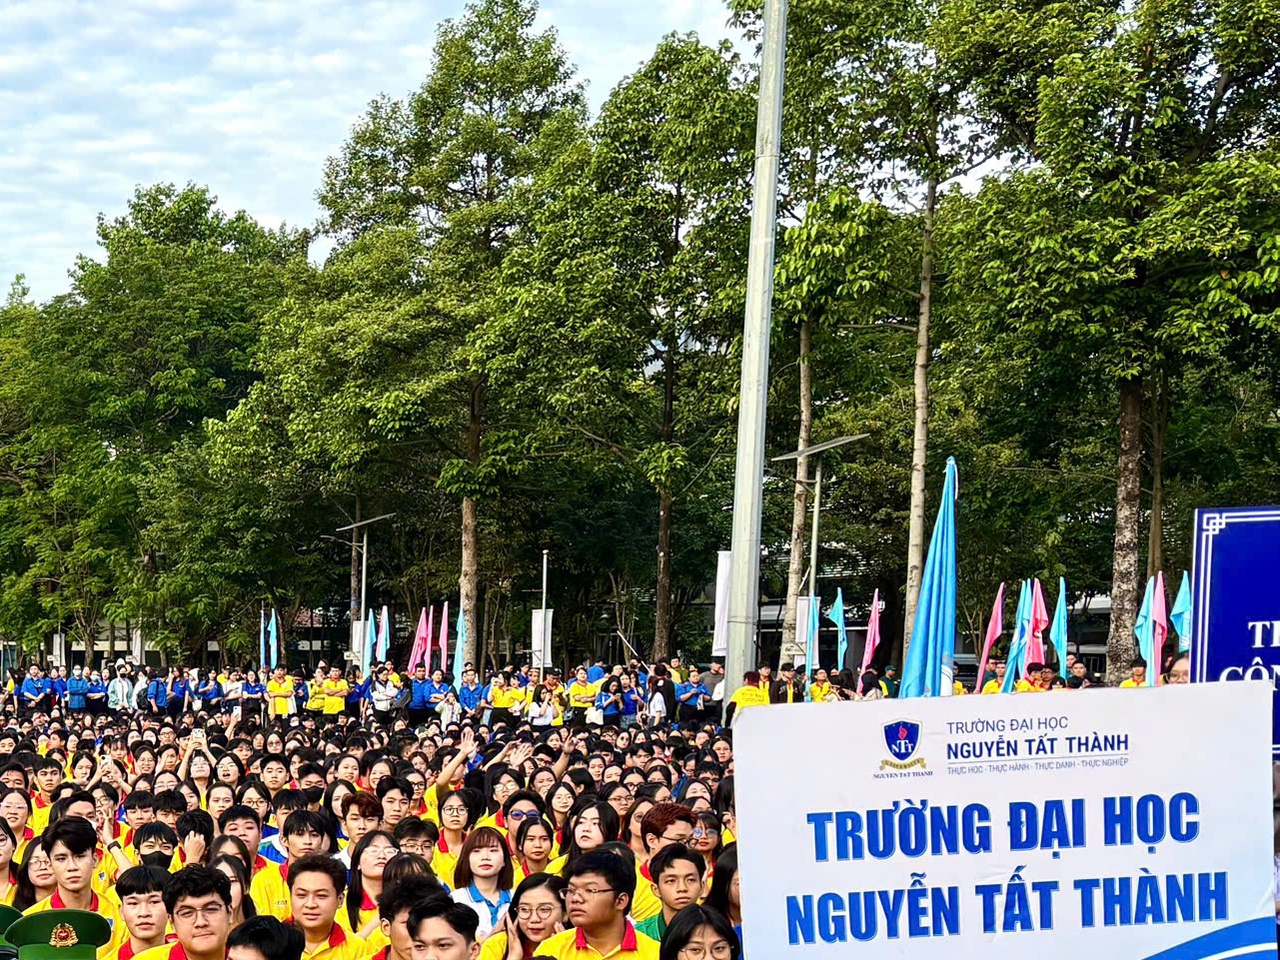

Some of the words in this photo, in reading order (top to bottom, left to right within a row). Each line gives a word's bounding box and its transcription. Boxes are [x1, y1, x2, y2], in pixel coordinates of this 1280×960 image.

[946, 718, 1006, 735] TRƯỜNG
[1009, 718, 1033, 733] ĐẠI
[1037, 716, 1069, 731] HỌC
[947, 735, 1018, 760] NGUYỄN
[1024, 733, 1058, 755] TẤT
[1065, 731, 1129, 753] THÀNH
[988, 764, 1008, 773] THỰC
[1009, 762, 1029, 771] HÀNH
[1035, 762, 1054, 771] THỰC
[1081, 759, 1100, 768] THỰC
[1102, 757, 1129, 767] NGHIỆP
[806, 798, 993, 862] TRƯỜNG
[1007, 798, 1087, 859] ĐẠI
[1103, 792, 1200, 854] HỌC
[786, 872, 961, 945] NGUYỄN
[975, 865, 1060, 934] TẤT
[1073, 867, 1229, 929] THÀNH
